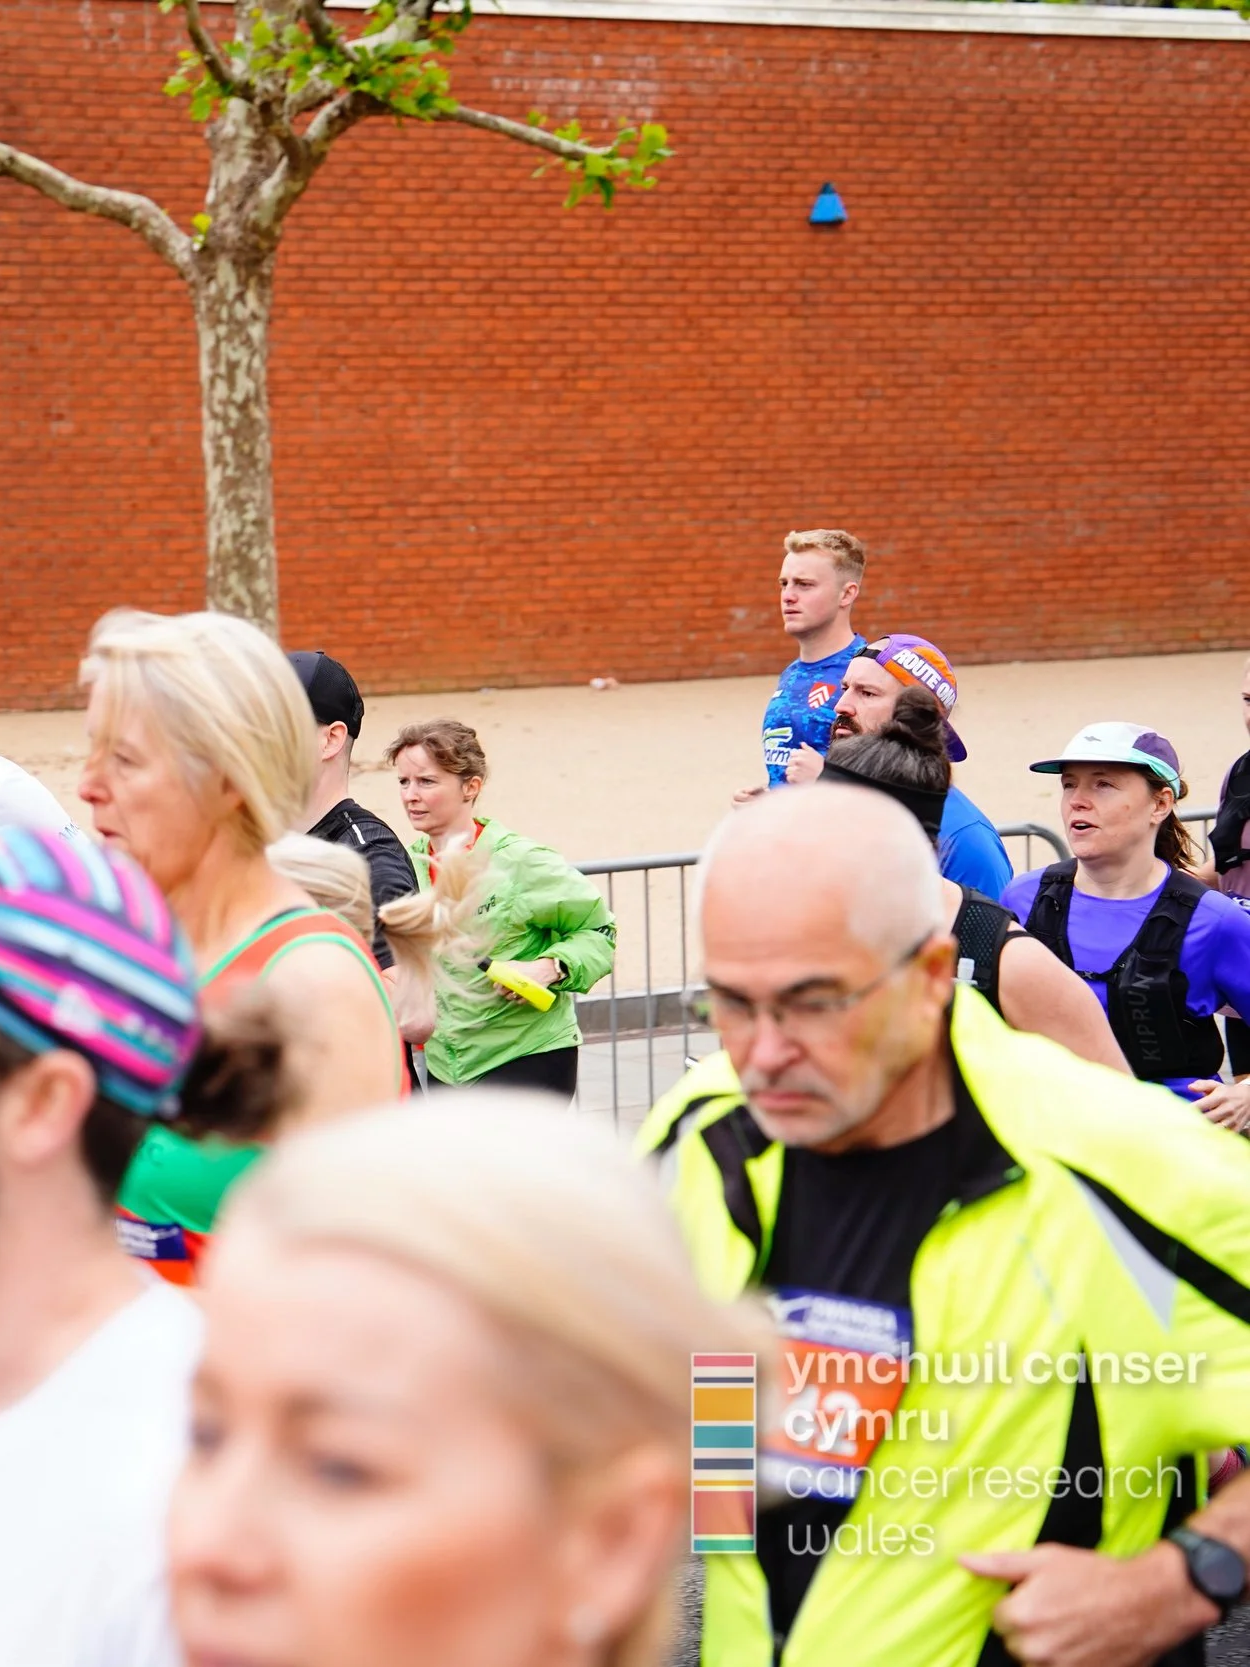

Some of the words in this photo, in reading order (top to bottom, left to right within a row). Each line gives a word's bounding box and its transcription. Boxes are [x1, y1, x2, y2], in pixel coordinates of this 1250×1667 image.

[891, 649, 942, 690] ROUTE
[936, 682, 956, 711] ON
[1128, 973, 1163, 1063] KIPRUN
